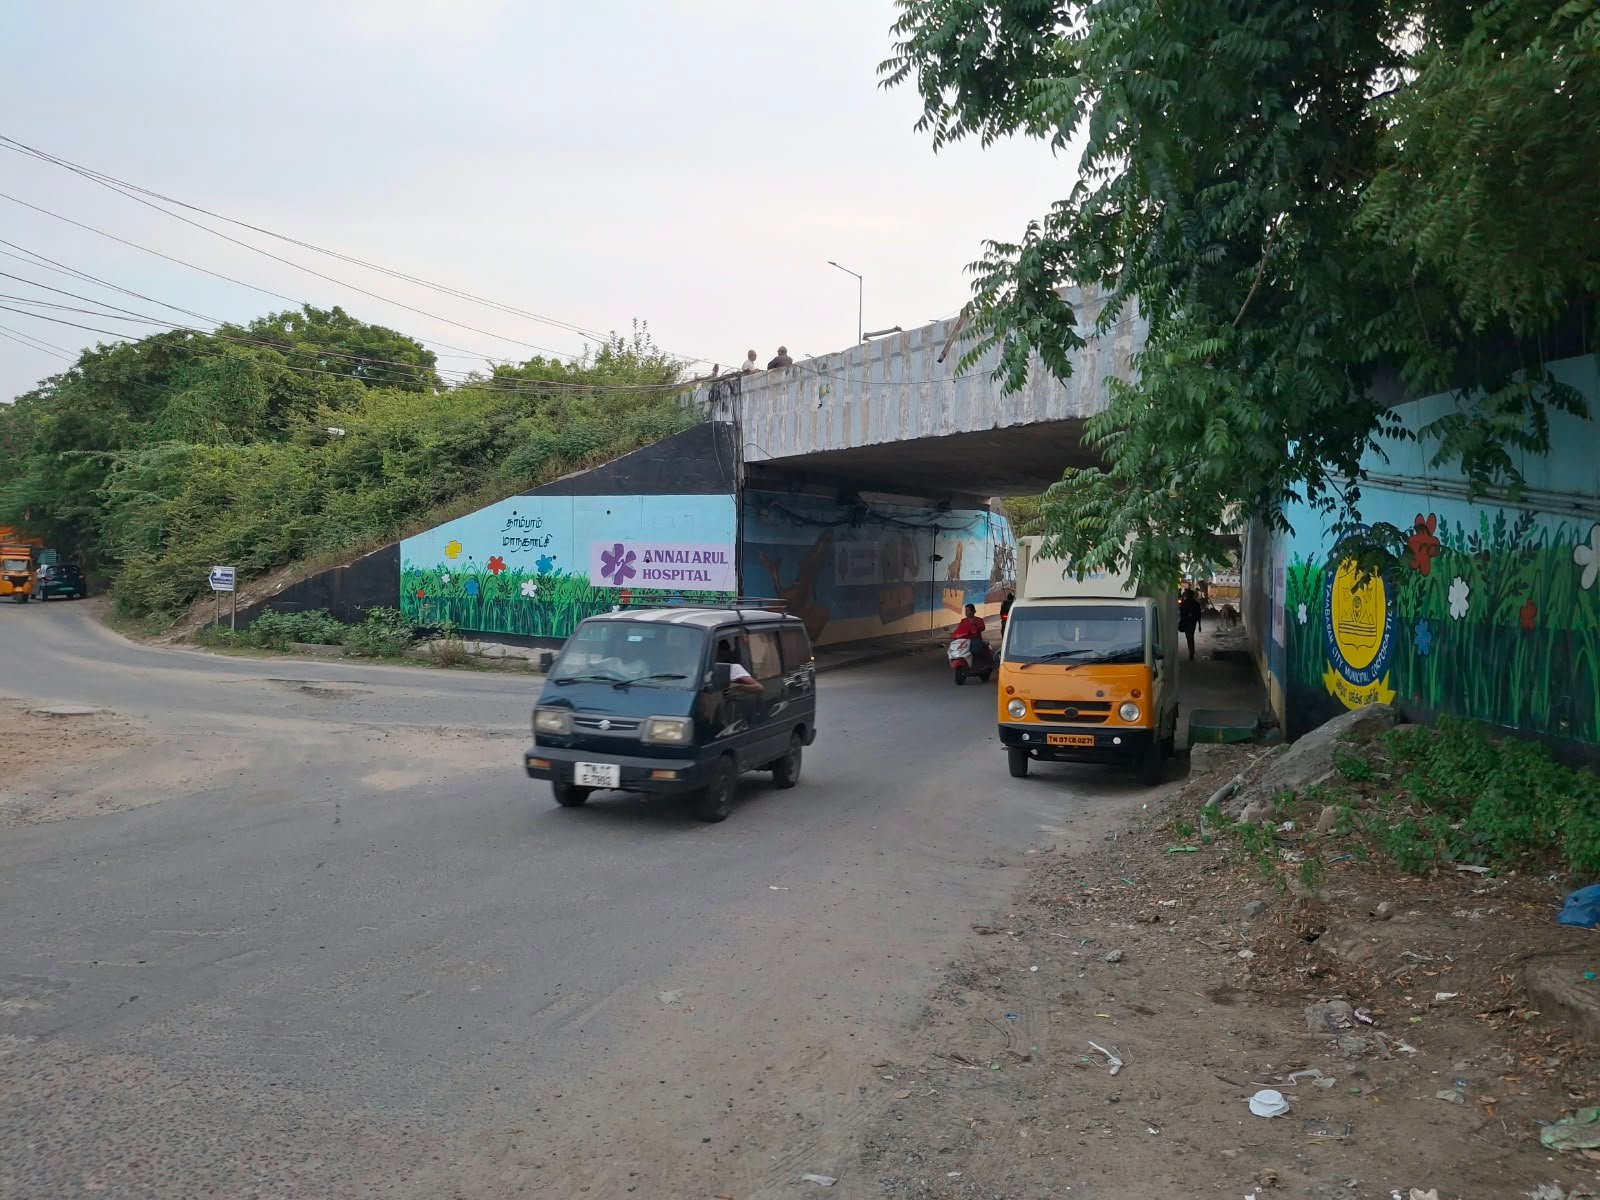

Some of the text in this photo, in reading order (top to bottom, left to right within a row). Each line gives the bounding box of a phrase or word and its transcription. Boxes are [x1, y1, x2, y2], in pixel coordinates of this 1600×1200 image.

[501, 516, 543, 533] தாம்பரம்
[502, 533, 553, 553] மாநகராட்சி
[643, 550, 729, 565] ANNAI ARUL
[643, 569, 712, 582] HOSPITAL
[1324, 583, 1334, 645] TAMBARAM
[1332, 646, 1344, 669] CITY
